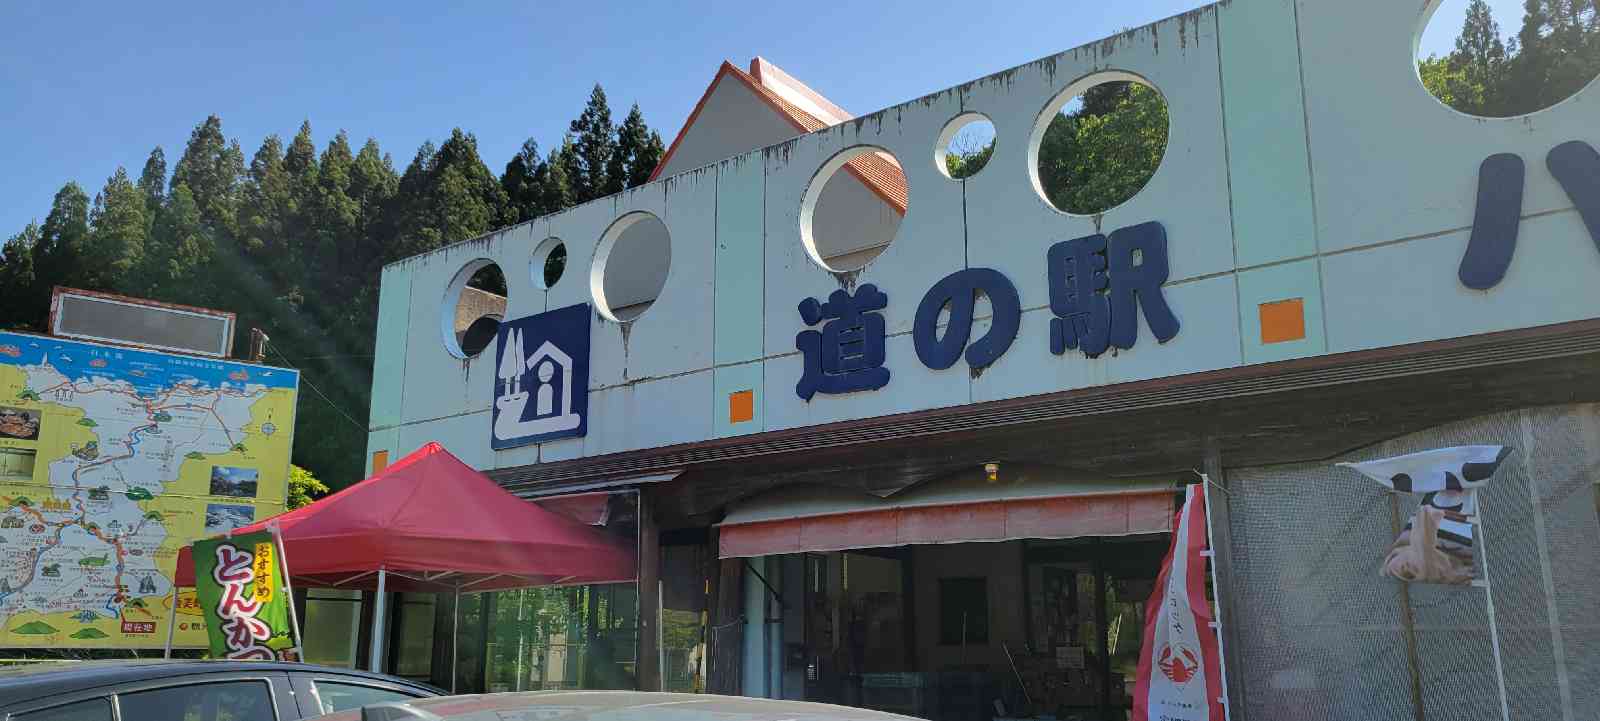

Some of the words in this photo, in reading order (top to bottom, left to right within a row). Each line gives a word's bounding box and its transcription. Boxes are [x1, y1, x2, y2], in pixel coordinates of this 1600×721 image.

[796, 221, 1180, 400] 道の駅
[256, 543, 271, 600] おすすめ
